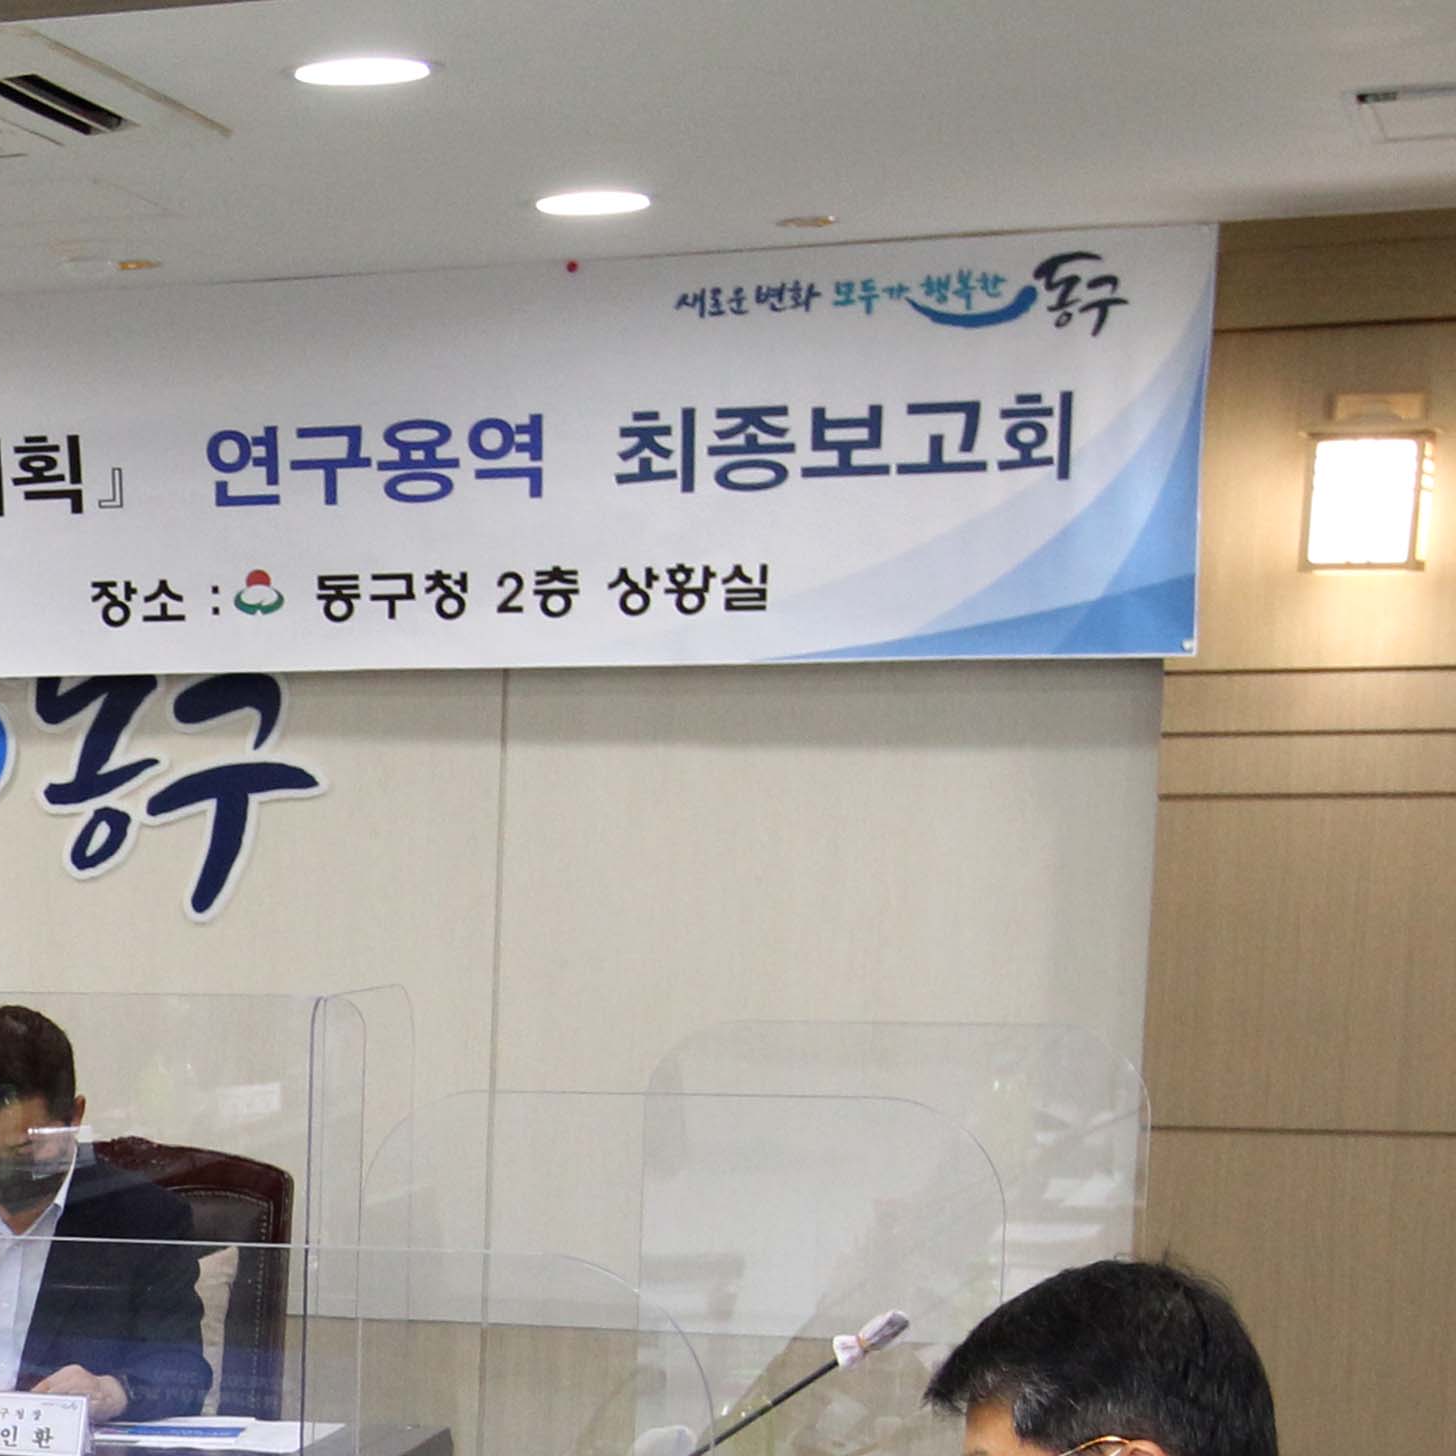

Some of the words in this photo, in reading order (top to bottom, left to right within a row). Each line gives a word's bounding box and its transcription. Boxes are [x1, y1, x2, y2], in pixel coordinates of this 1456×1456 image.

[674, 287, 749, 319] 새로운
[755, 279, 821, 312] 변화
[833, 276, 910, 314] 모두가
[920, 269, 1006, 311] 행복한
[1033, 250, 1129, 337] 동구
[205, 412, 548, 510] 연구용역
[613, 389, 1077, 495] 최종보고회
[89, 575, 187, 629] 장소
[315, 565, 472, 621] 동구청
[495, 563, 581, 617] 2층
[606, 560, 773, 614] 상황실
